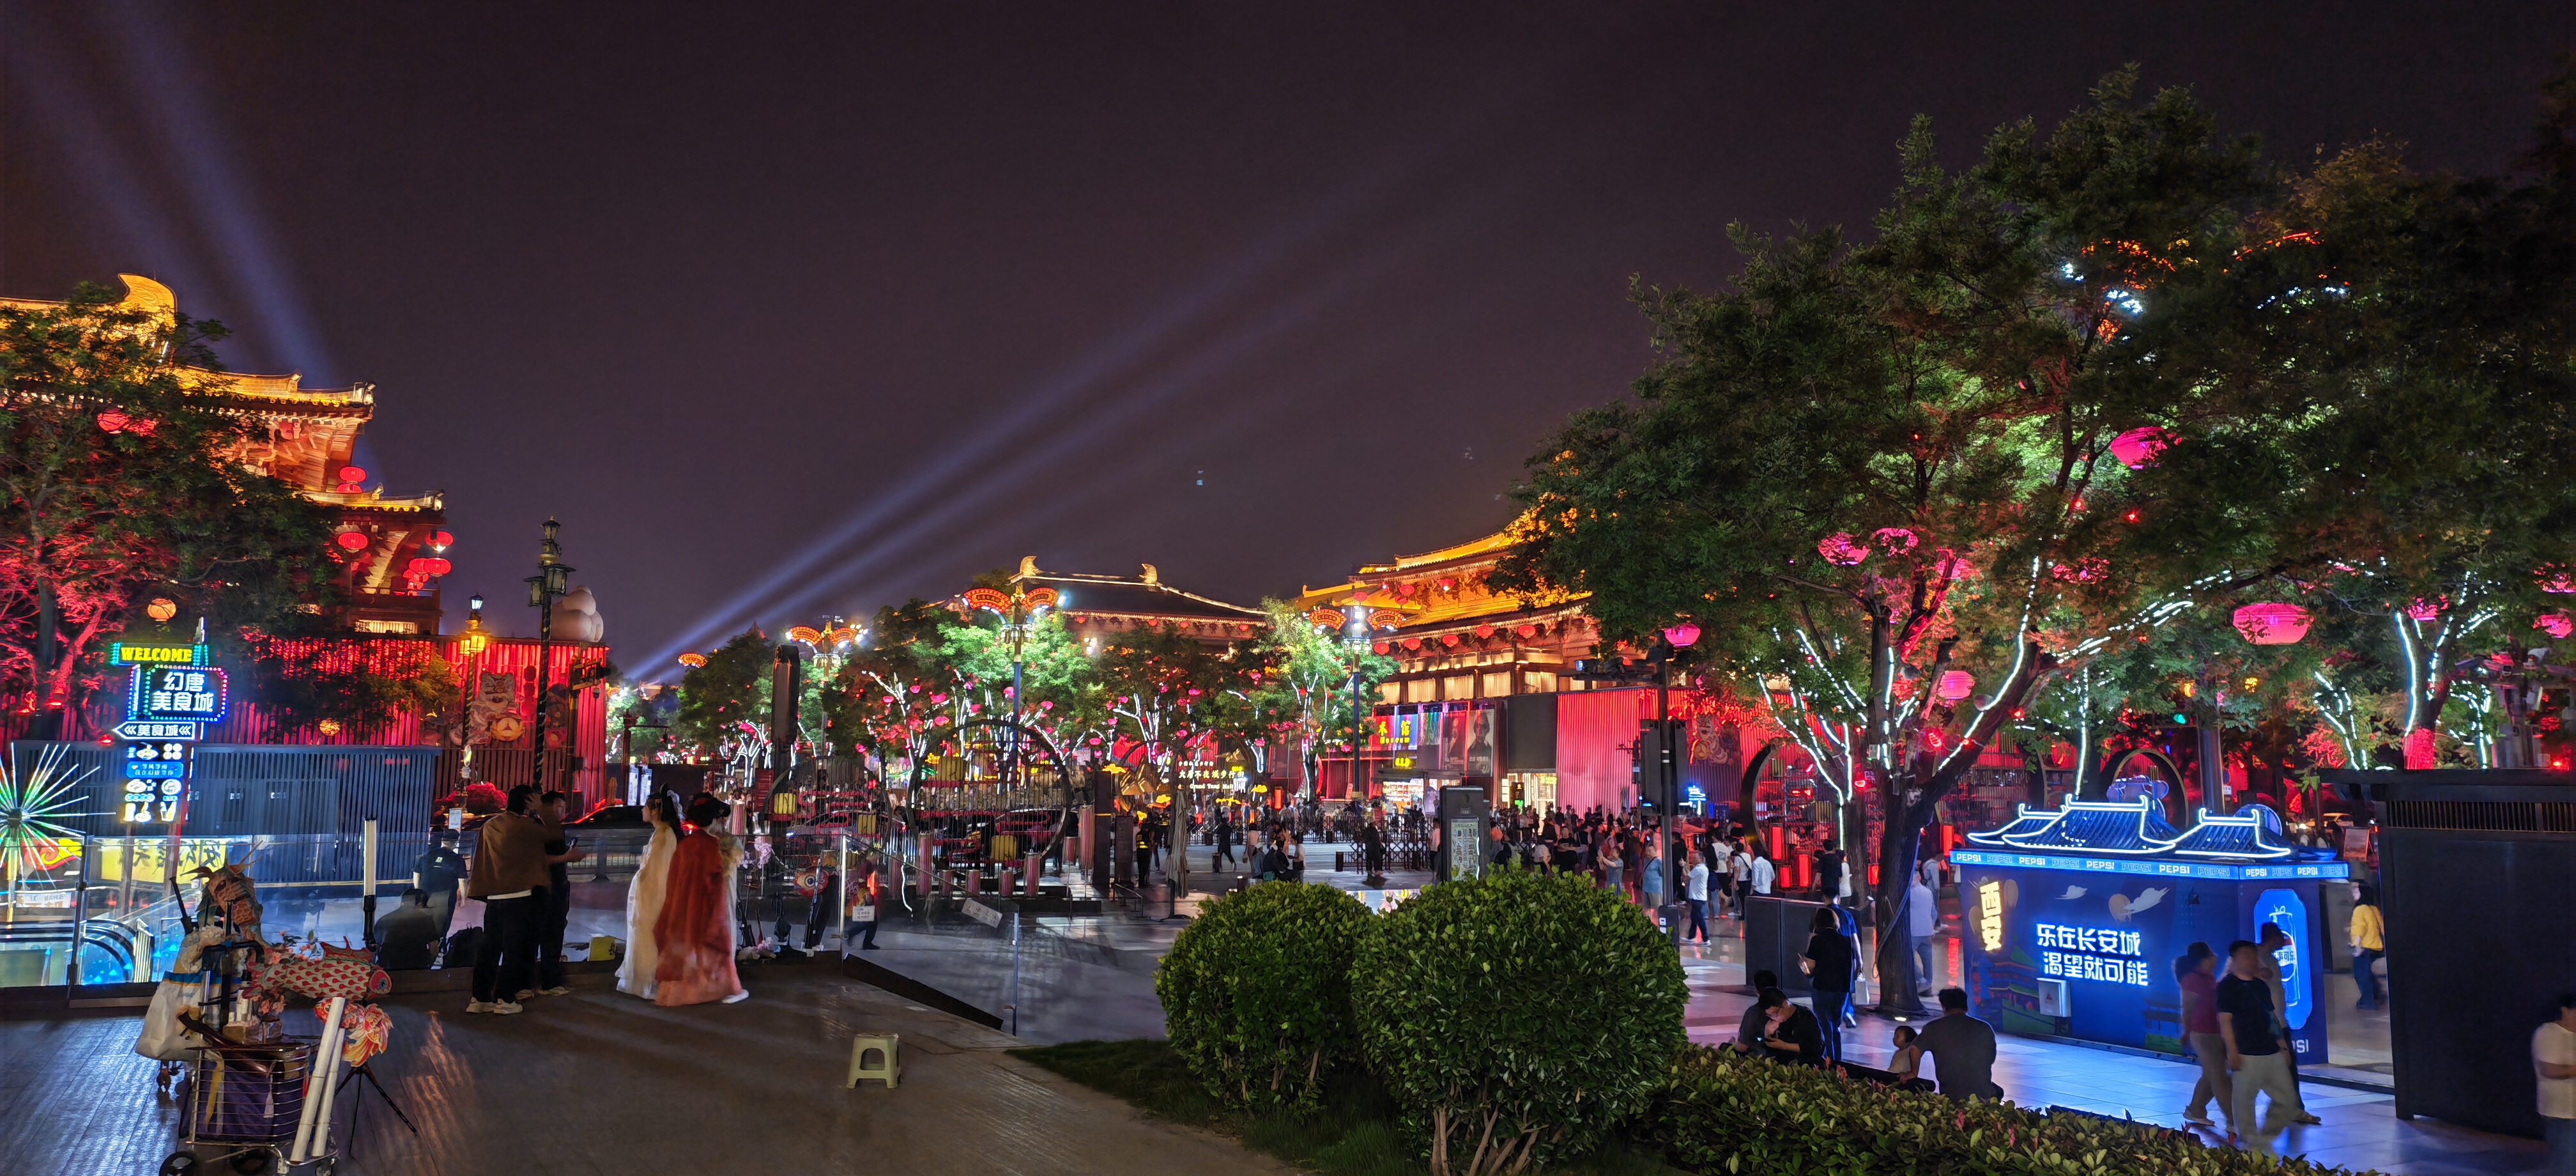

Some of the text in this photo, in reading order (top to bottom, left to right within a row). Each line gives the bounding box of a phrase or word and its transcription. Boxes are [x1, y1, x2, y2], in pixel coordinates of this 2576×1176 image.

[121, 647, 192, 662] WELCOME
[164, 672, 205, 692] 幻唐
[151, 692, 213, 712] 美食城
[137, 724, 178, 736] 美食城
[1956, 853, 2230, 877] PEPSI PEPSI PEPSI PEPSI PEPSI PEPSI PEPSI PEPSI
[2245, 865, 2343, 877] PEPSI PEPSI PEPSI PEPSI
[1980, 881, 2002, 951] 西安
[2036, 924, 2141, 956] 乐在长安城
[2043, 951, 2149, 986] 渴望就可能
